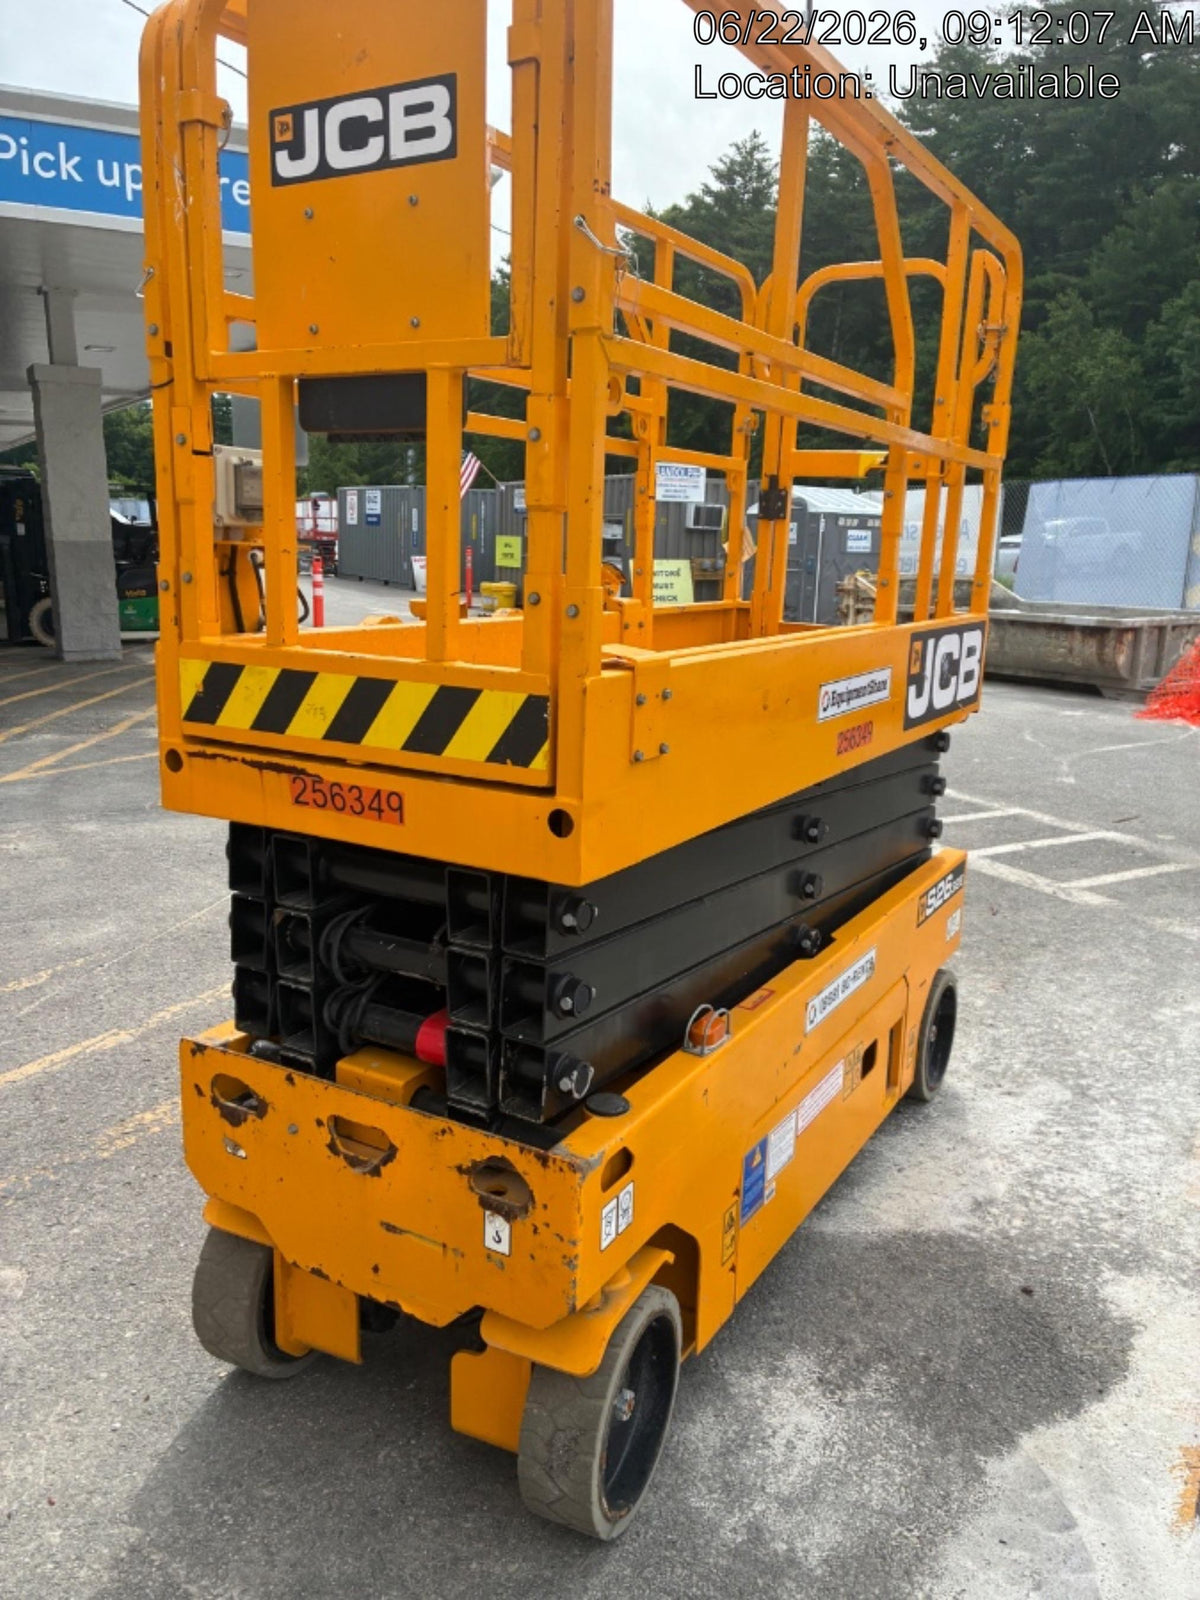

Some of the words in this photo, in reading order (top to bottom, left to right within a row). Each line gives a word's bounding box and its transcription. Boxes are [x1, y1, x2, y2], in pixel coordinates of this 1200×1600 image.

[0, 134, 84, 183] Pick
[97, 159, 142, 201] up
[274, 84, 453, 179] JCB
[908, 629, 983, 719] JCB
[291, 776, 404, 824] 256349
